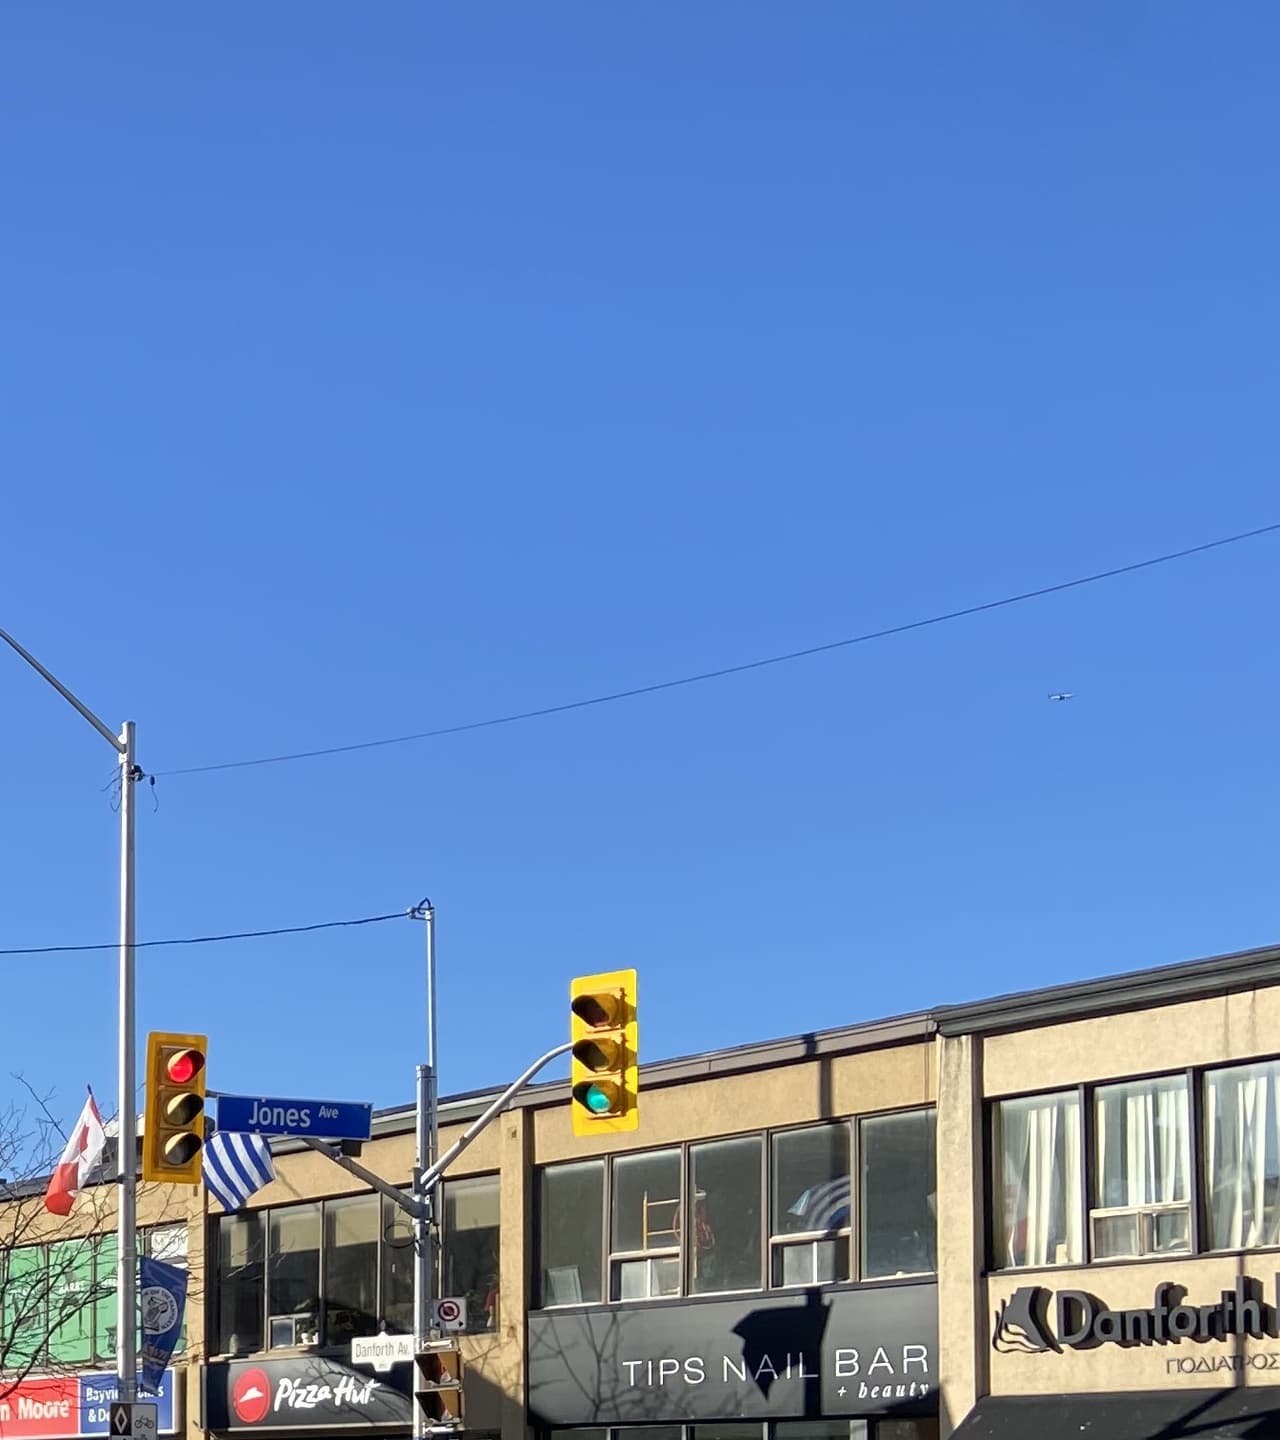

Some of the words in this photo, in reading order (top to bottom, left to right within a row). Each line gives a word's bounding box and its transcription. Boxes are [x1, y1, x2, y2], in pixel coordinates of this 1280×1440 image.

[248, 1101, 311, 1128] Jones
[318, 1105, 339, 1119] Ave
[1056, 1275, 1264, 1349] Danforth
[355, 1343, 394, 1358] Danforth
[397, 1341, 410, 1354] Av.
[623, 1357, 705, 1386] TIPS
[723, 1351, 819, 1383] NAIL
[835, 1344, 928, 1377] BAR
[274, 1376, 332, 1412] Pizza
[332, 1375, 382, 1407] Hut
[858, 1381, 929, 1399] beauty
[18, 1397, 69, 1419] Moore
[88, 1409, 96, 1423] &
